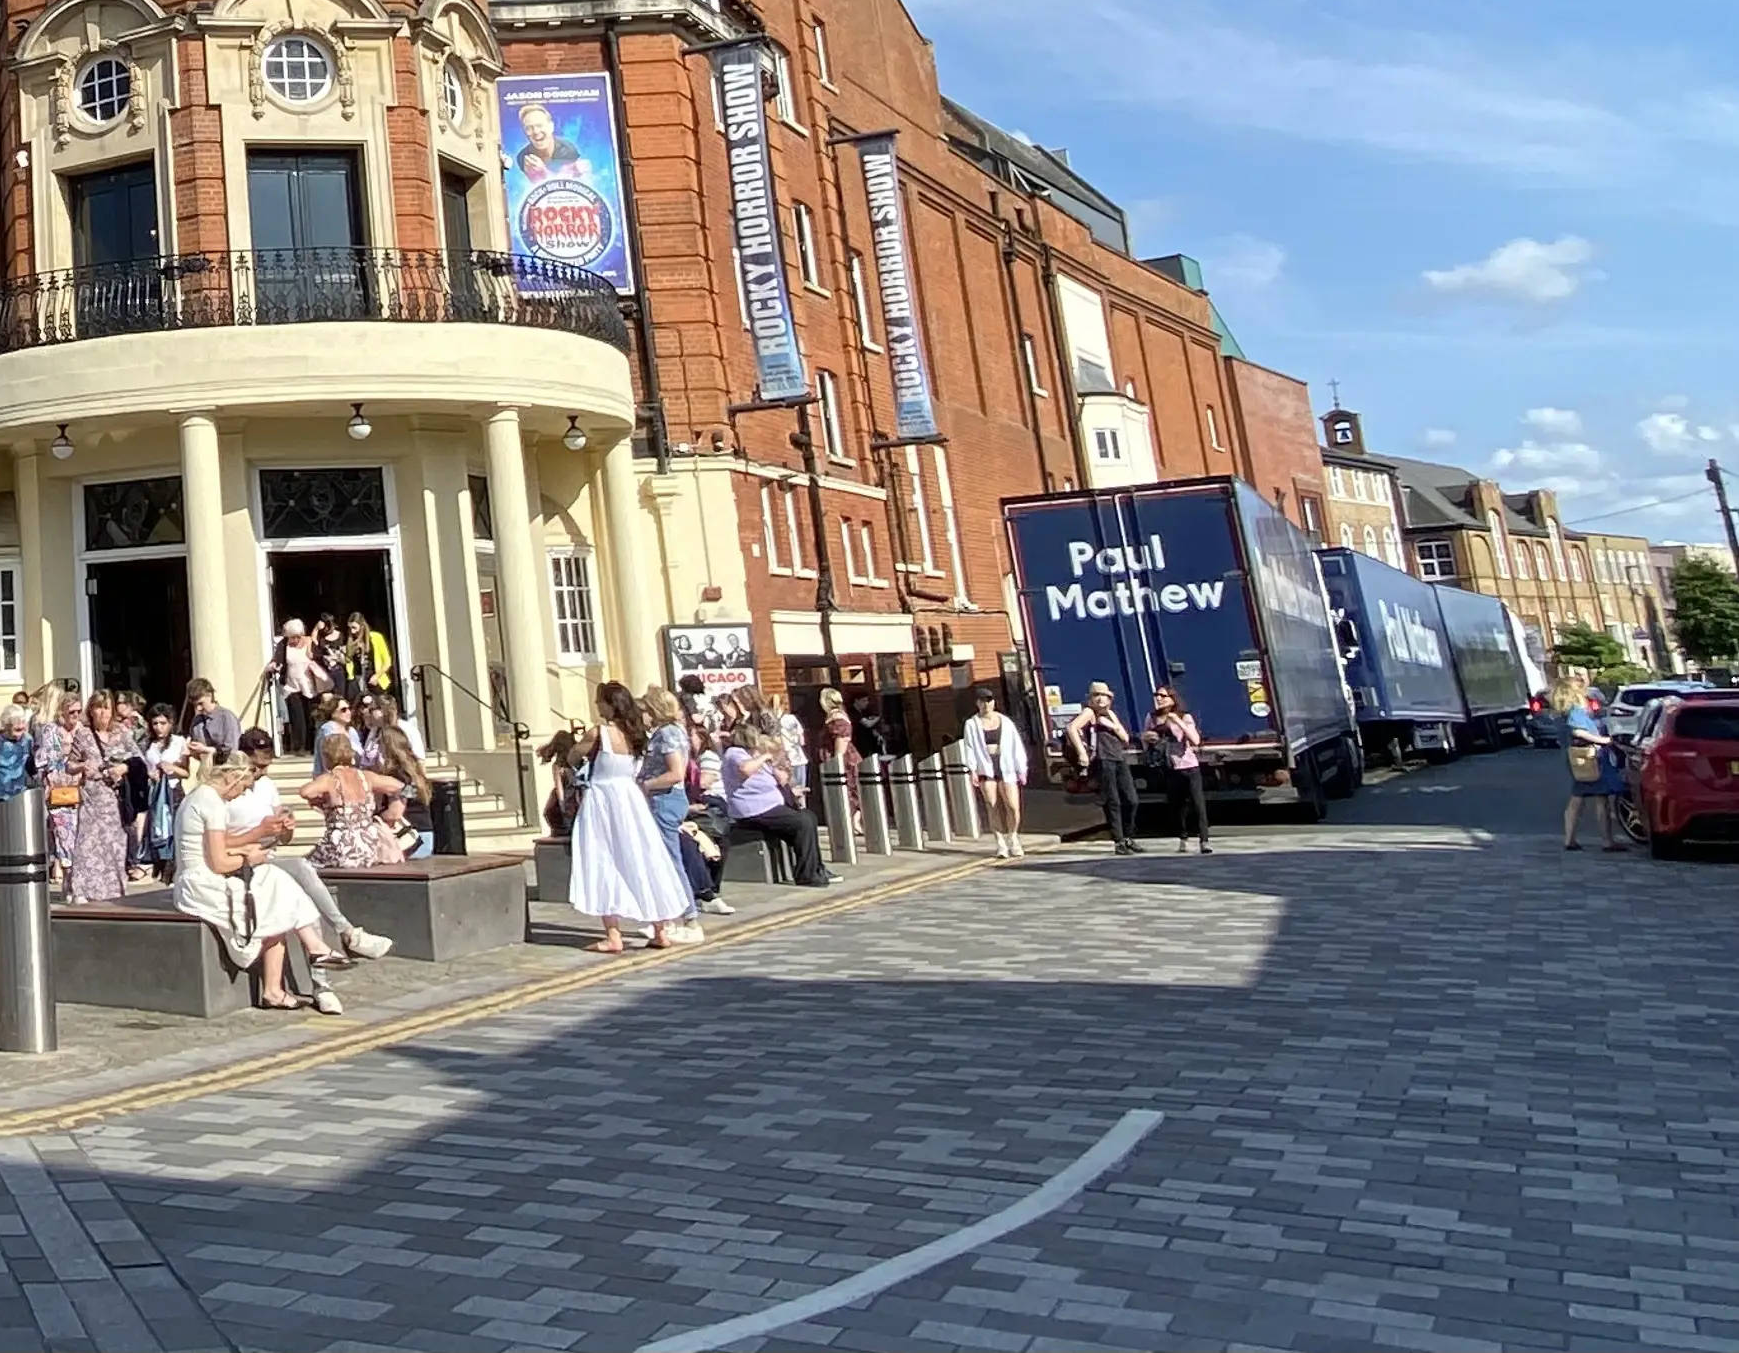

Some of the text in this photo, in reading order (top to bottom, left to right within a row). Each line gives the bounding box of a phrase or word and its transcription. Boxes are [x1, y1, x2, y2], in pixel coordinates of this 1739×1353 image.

[504, 91, 542, 101] JASON
[724, 63, 760, 139] SHOW
[528, 205, 599, 223] ROCKY
[732, 143, 774, 254] HORROR
[863, 154, 896, 220] SHOW
[546, 239, 590, 249] Show
[874, 224, 911, 319] HORROR
[743, 263, 790, 356] ROCKY
[888, 325, 923, 403] ROCKY
[1068, 534, 1165, 578] Paul
[1046, 578, 1224, 621] Mathew
[701, 672, 747, 684] ICAGO
